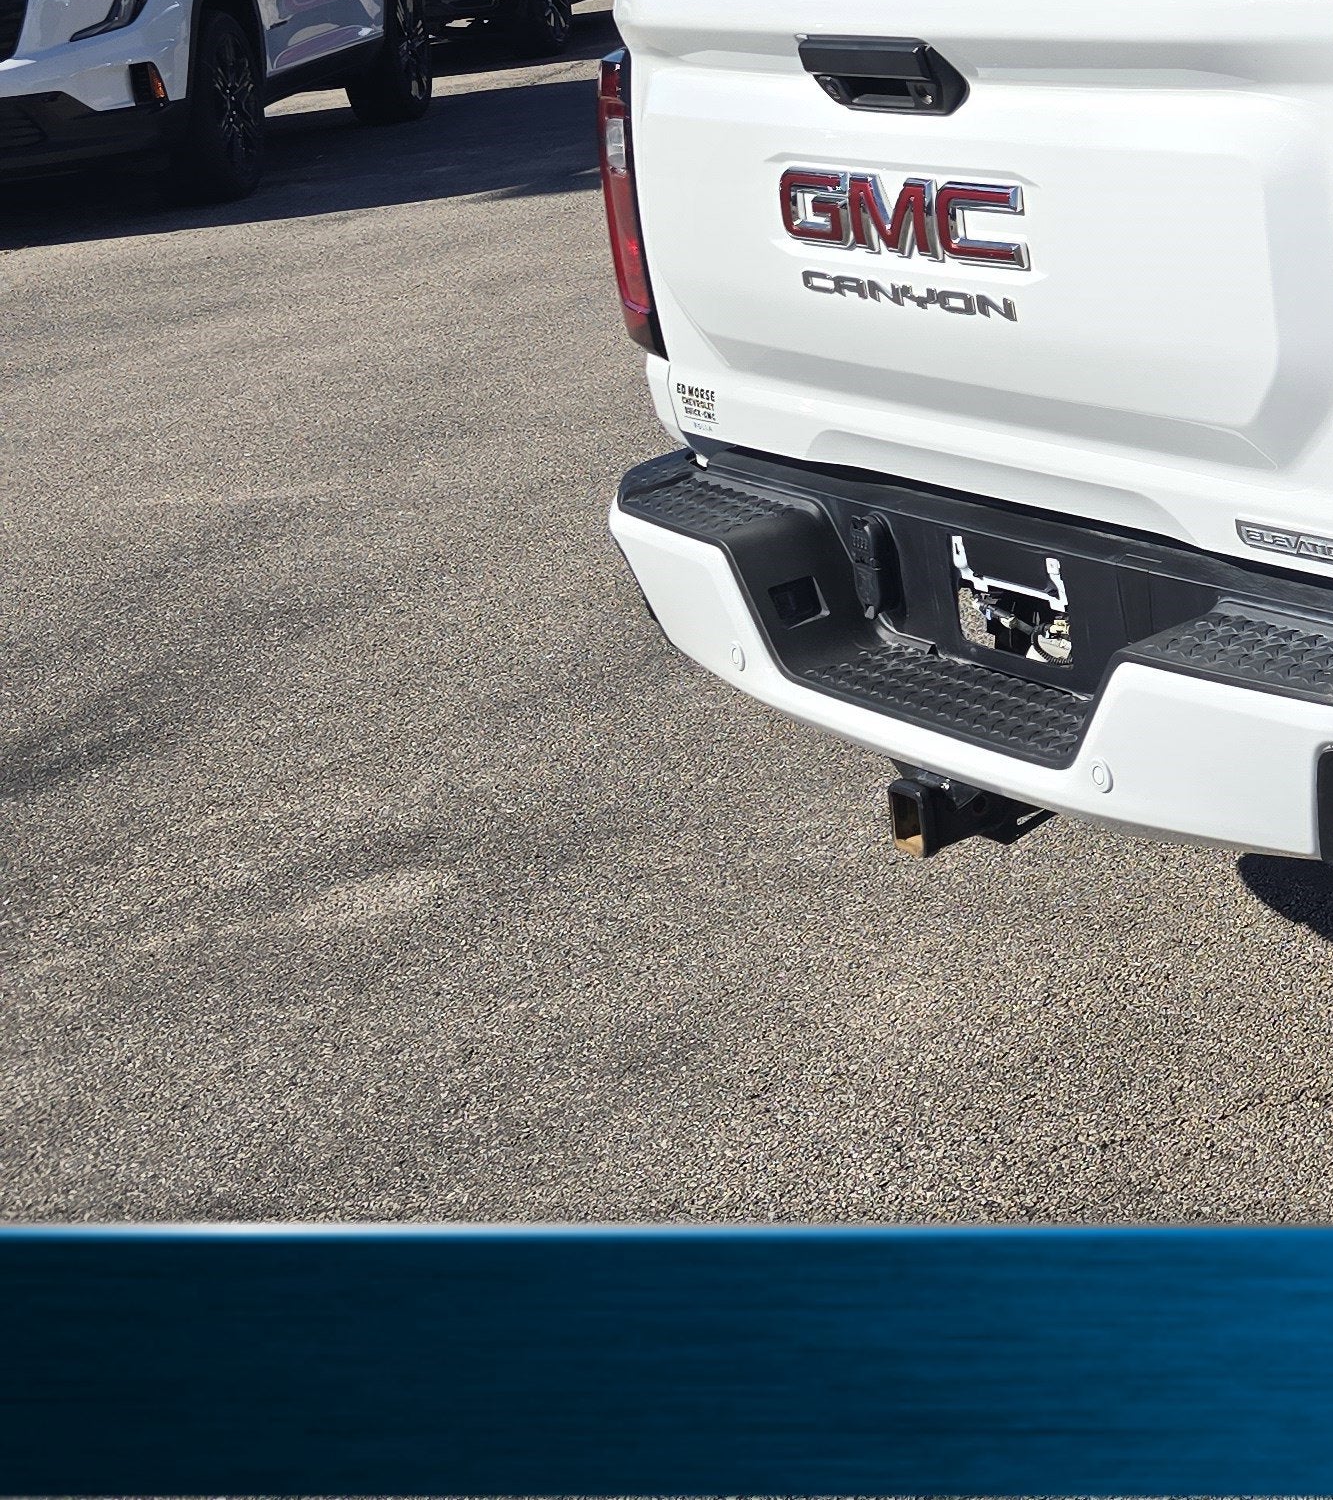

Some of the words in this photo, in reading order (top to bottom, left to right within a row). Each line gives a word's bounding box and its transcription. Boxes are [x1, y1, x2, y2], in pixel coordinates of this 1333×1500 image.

[779, 166, 1031, 271] GMC
[801, 269, 1018, 322] CANYON
[676, 382, 686, 395] ED
[687, 386, 716, 402] MORSE
